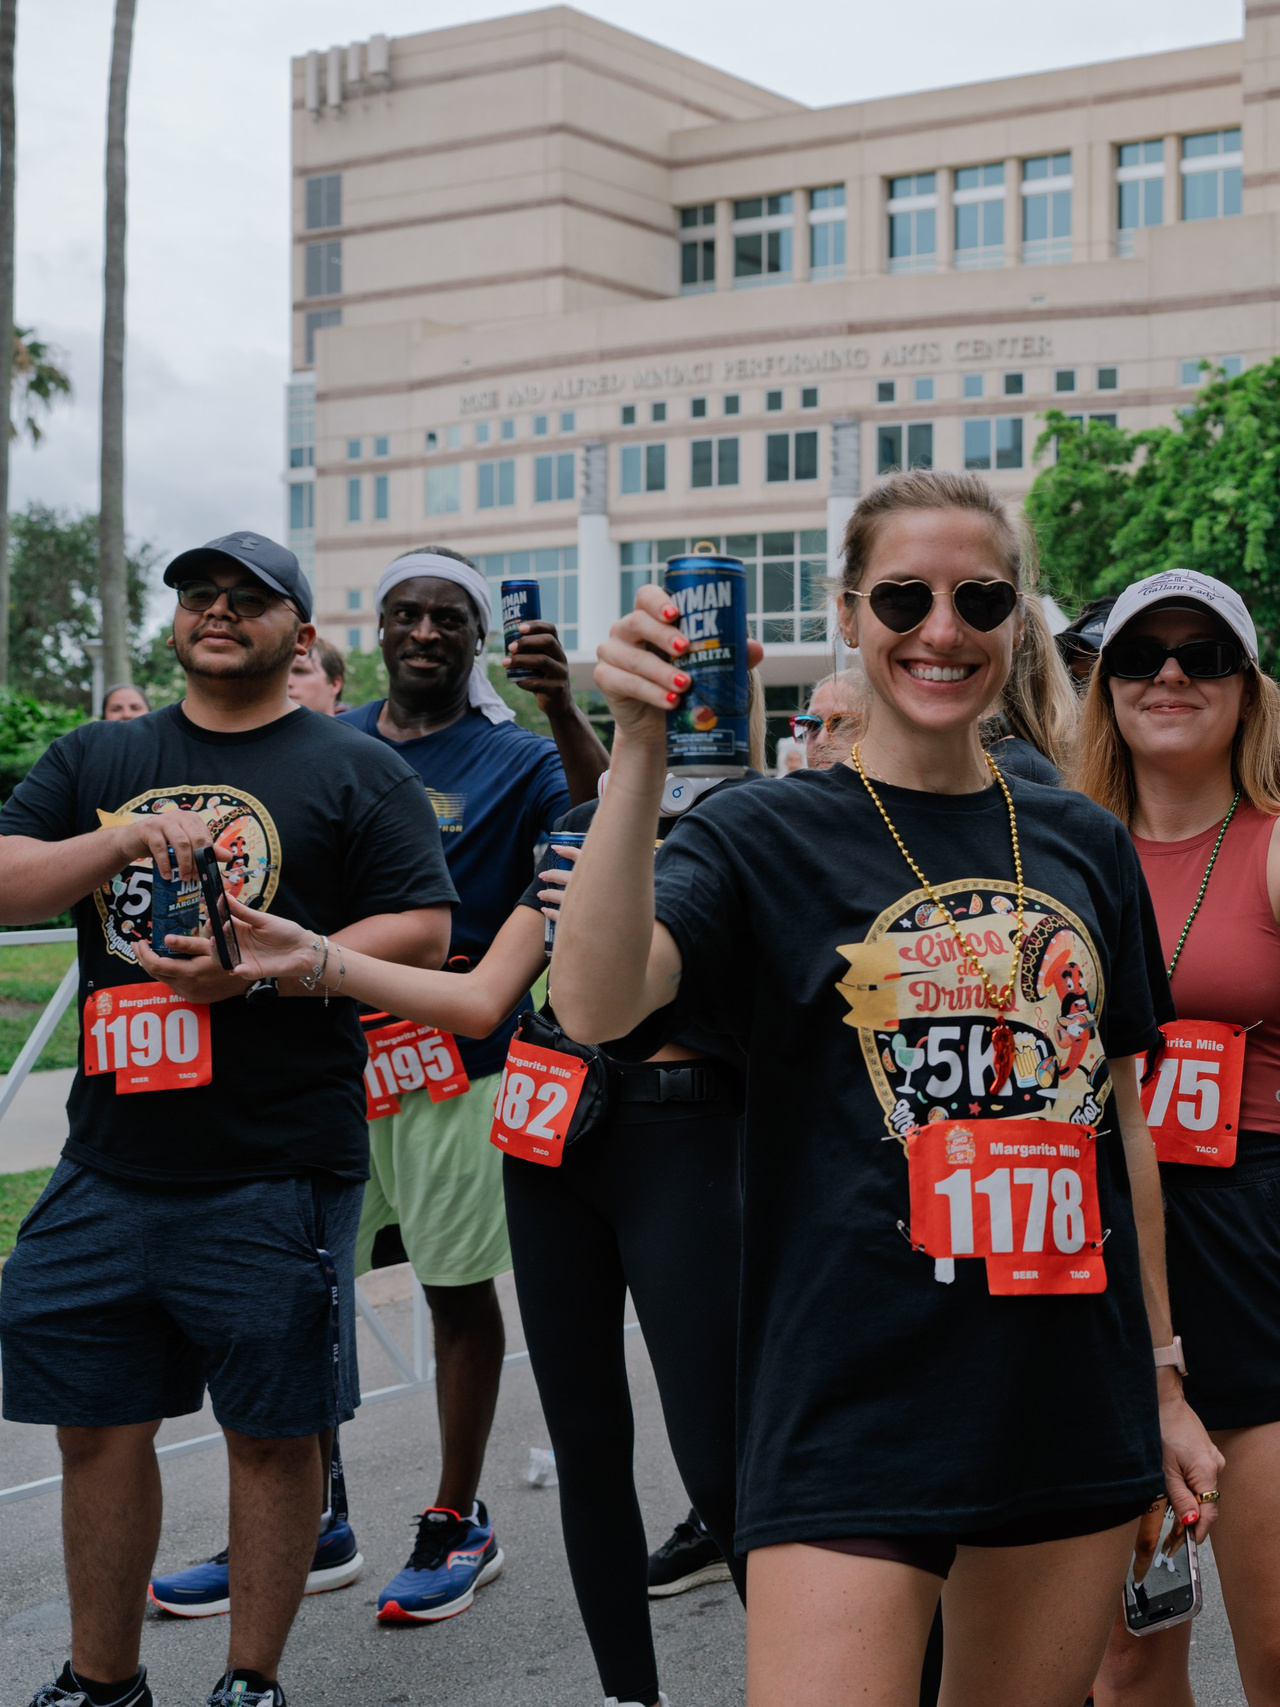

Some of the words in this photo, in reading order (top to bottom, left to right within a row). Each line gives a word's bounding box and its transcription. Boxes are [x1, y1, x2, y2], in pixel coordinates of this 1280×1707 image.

[506, 382, 547, 407] AND
[723, 346, 870, 382] PERFORMING
[882, 341, 943, 367] ARTS
[953, 335, 1055, 361] CENTER
[1142, 584, 1184, 597] Gallant
[1188, 586, 1215, 601] Lady
[898, 930, 1009, 967] Cinco
[119, 997, 167, 1008] Margarita
[90, 1008, 200, 1071] 1190
[1196, 1039, 1225, 1052] Mile
[363, 1034, 454, 1099] 1195
[925, 1024, 1013, 1098] 5K
[549, 1065, 572, 1079] Mile
[532, 1146, 549, 1157] TACO
[989, 1142, 1057, 1158] Margarita
[1059, 1143, 1081, 1158] Mile
[1195, 1145, 1219, 1155] TACO
[934, 1167, 1086, 1255] 1178
[1012, 1271, 1039, 1279] BEER
[1070, 1271, 1090, 1279] TACO
